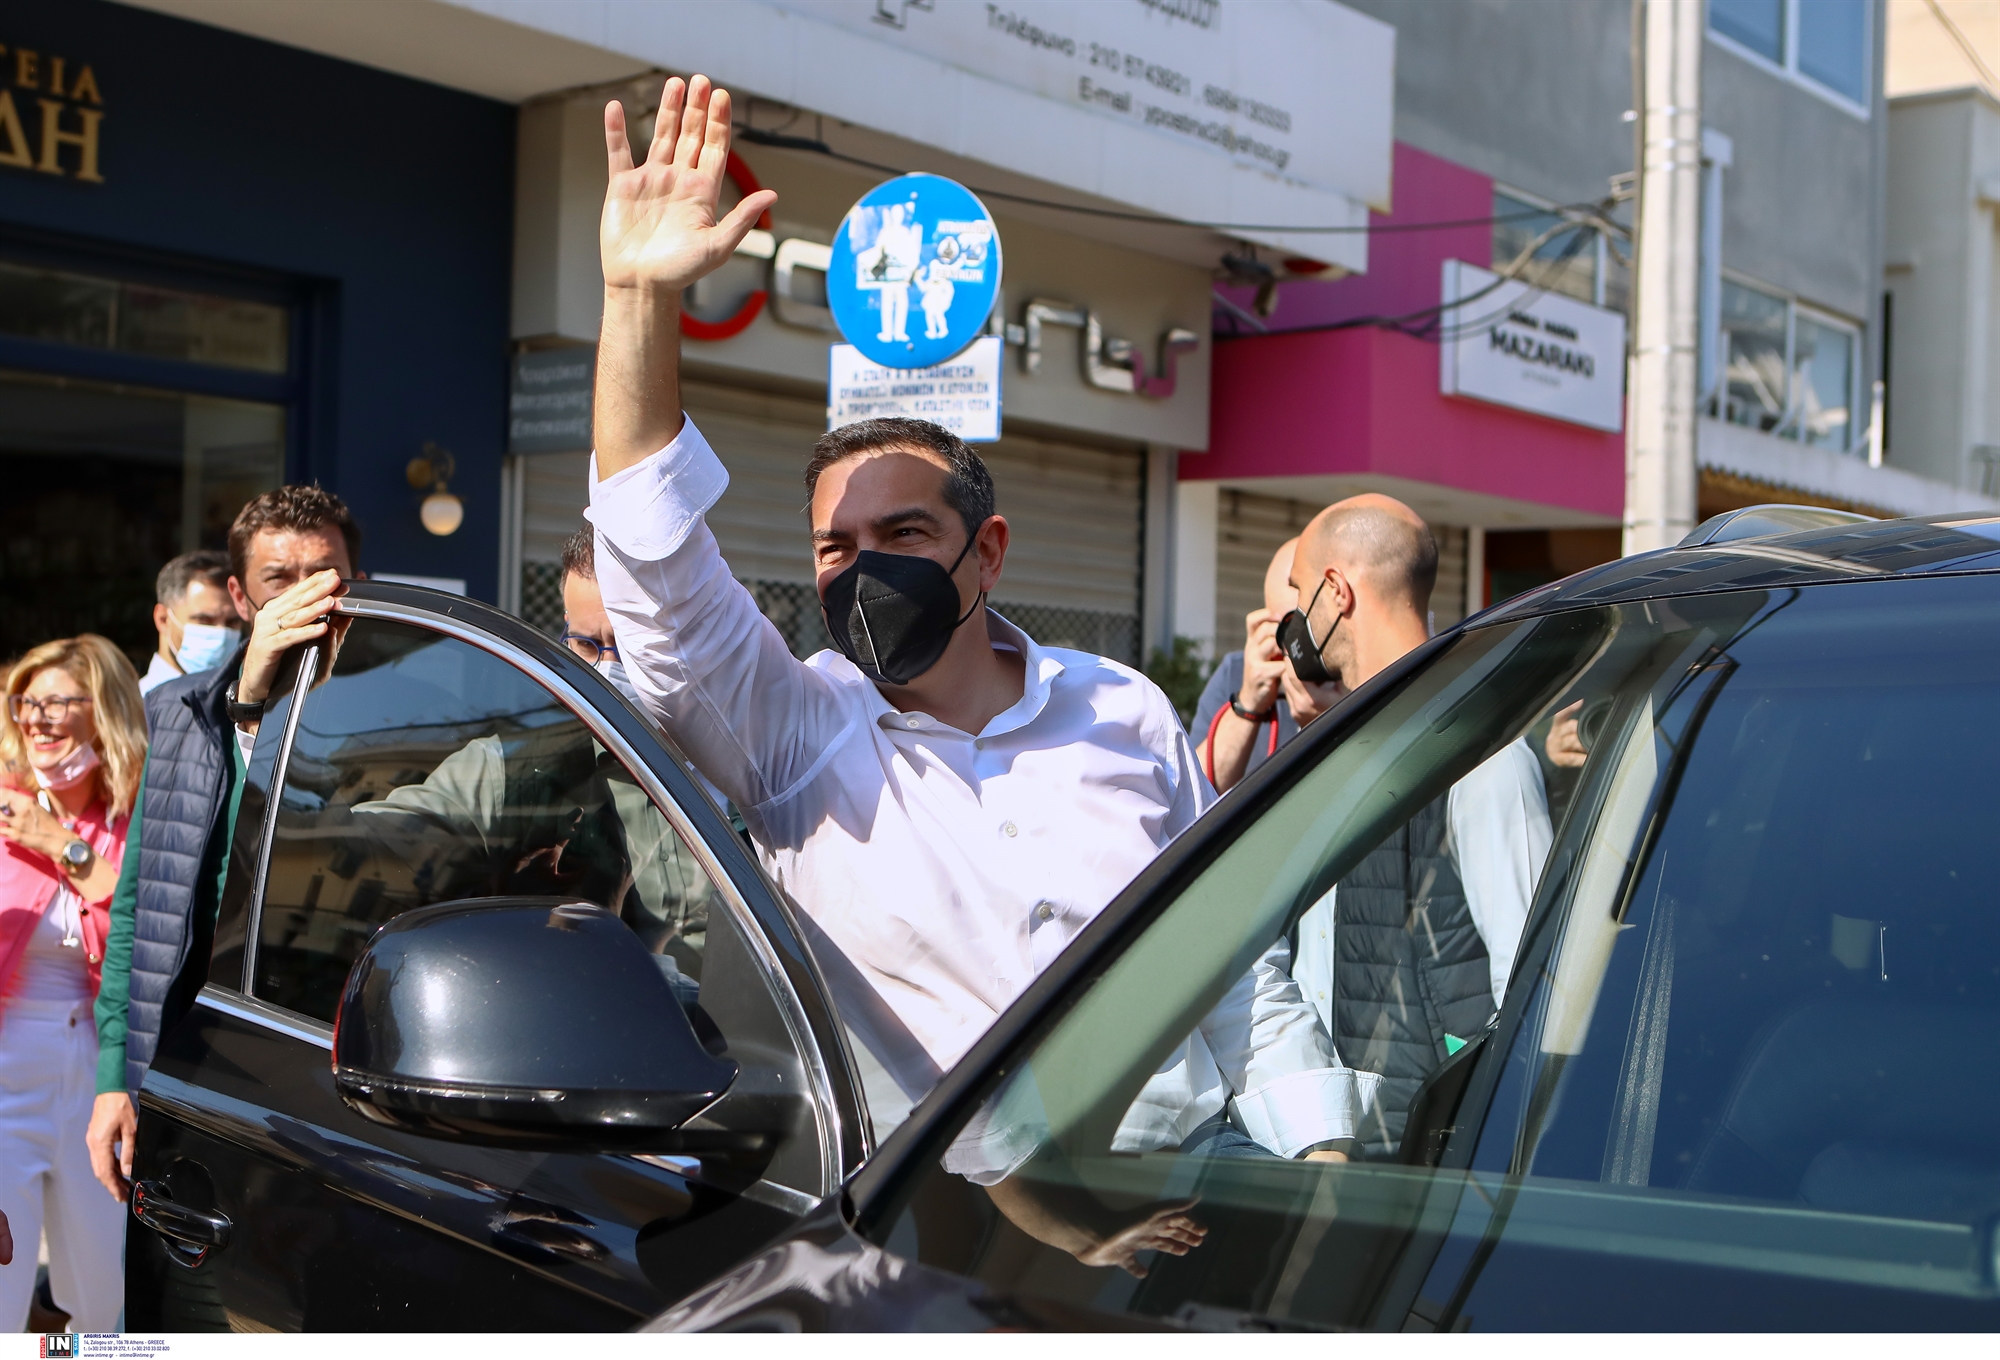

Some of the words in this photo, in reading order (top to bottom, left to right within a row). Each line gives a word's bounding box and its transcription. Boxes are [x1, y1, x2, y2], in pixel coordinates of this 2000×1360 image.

[0, 43, 102, 104] ΕΙΑ
[1089, 42, 1120, 73] 210
[1490, 325, 1594, 379] MAZARAKI
